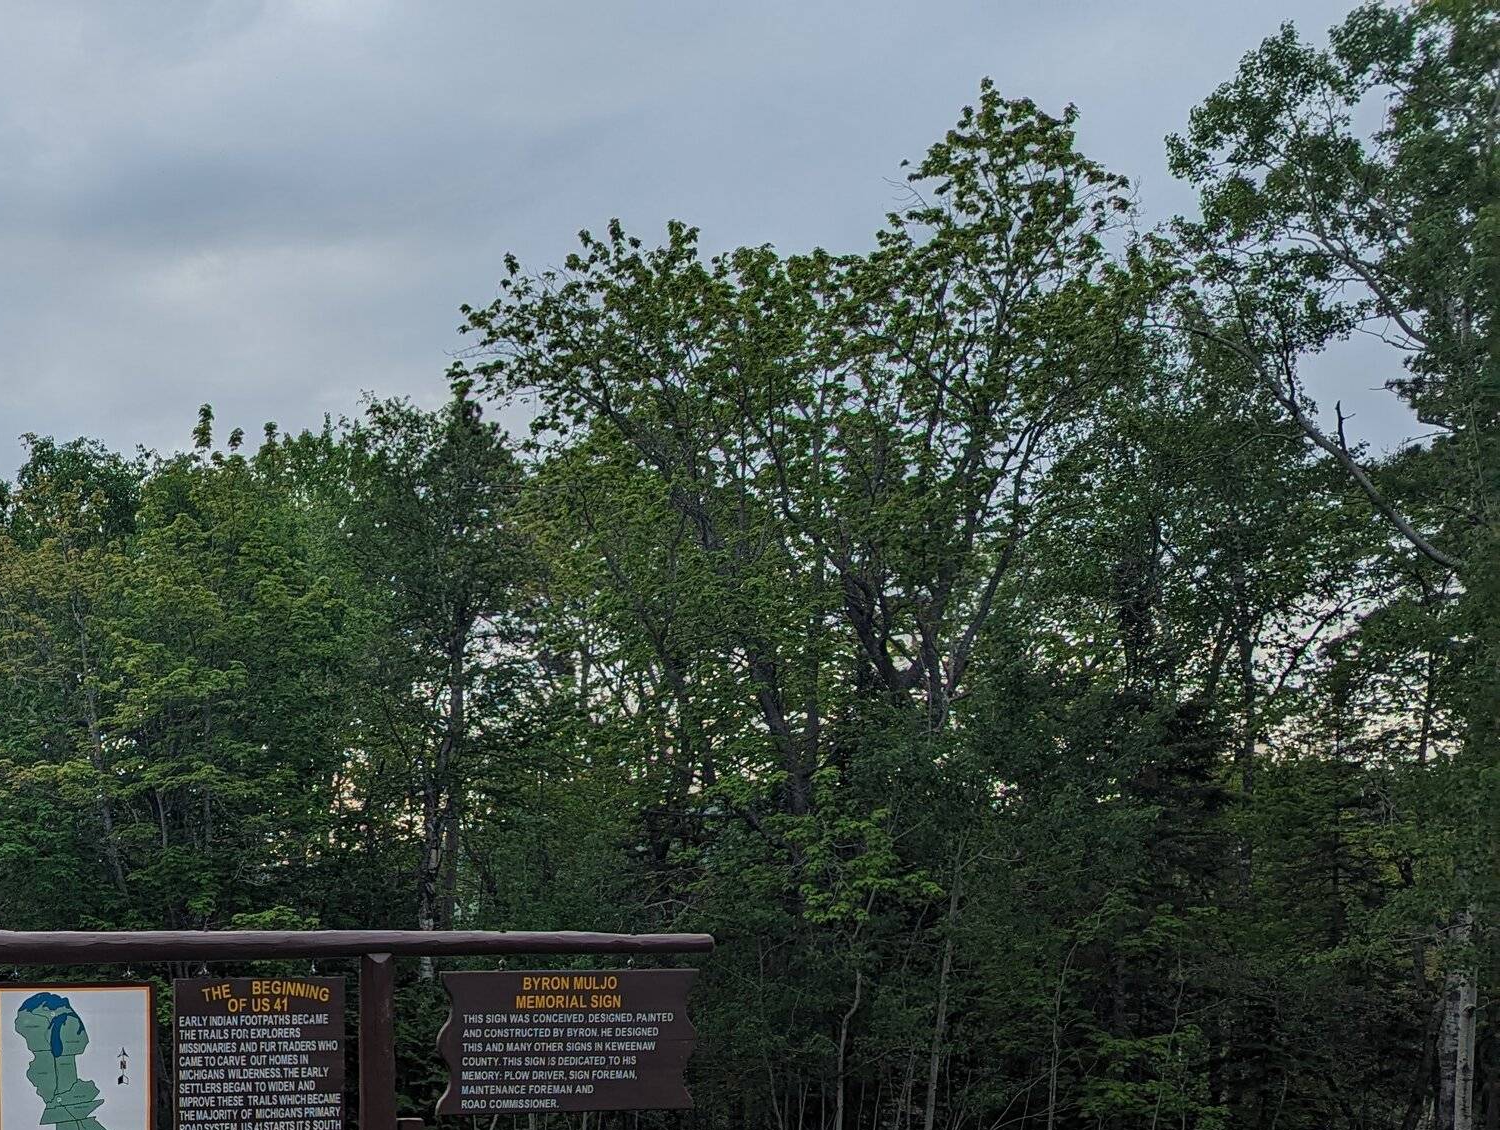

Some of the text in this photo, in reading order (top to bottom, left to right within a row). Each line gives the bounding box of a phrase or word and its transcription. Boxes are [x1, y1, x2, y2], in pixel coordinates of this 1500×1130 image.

[523, 976, 617, 990] BYRON MULJO
[202, 981, 330, 1002] THE BEGINNING
[227, 997, 288, 1012] OF US 41
[516, 995, 621, 1009] MEMORIAL SIGN
[179, 1013, 329, 1027] EARLY INDIAN FOOTPATHS BECAME
[463, 1014, 483, 1024] THIS
[485, 1014, 507, 1024] SIGN
[510, 1014, 530, 1023] WAS
[636, 1012, 673, 1023] PAINTED
[179, 1027, 301, 1040] THE TRAILS FOR EXPLORERS
[462, 1028, 482, 1038] AND
[484, 1028, 551, 1038] CONSTRUCTED
[552, 1028, 564, 1037] BY
[601, 1027, 613, 1037] HE
[615, 1027, 659, 1037] DESIGNED
[179, 1040, 338, 1053] MISSIONARIES AND FUR TRADERS WHO
[462, 1041, 656, 1052] THIS AND MANY OTHER SIGNS IN KEWEENAW
[179, 1054, 309, 1067] CAME TO CARVE OUT HOMES IN
[503, 1057, 522, 1066] THIS
[524, 1056, 546, 1066] SIGN
[548, 1056, 557, 1066] IS
[558, 1056, 606, 1066] DEDICATED
[608, 1056, 621, 1065] TO
[622, 1056, 636, 1065] HIS
[283, 1067, 300, 1078] THE
[301, 1067, 329, 1077] EARLY
[504, 1071, 529, 1080] PLOW
[569, 1070, 590, 1080] SIGN
[179, 1080, 316, 1093] SETTLERS BEGAN TO WIDEN AND
[461, 1085, 594, 1095] MAINTENANCE FOREMAN AND
[179, 1093, 341, 1107] IMPROVE THESE TRAILS WHICH BECAME
[461, 1099, 486, 1109] ROAD
[179, 1110, 195, 1121] THE
[196, 1109, 238, 1120] MAJORITY
[241, 1109, 253, 1119] OF
[304, 1107, 341, 1118] PRIMARY
[313, 1120, 341, 1130] SOUTH
